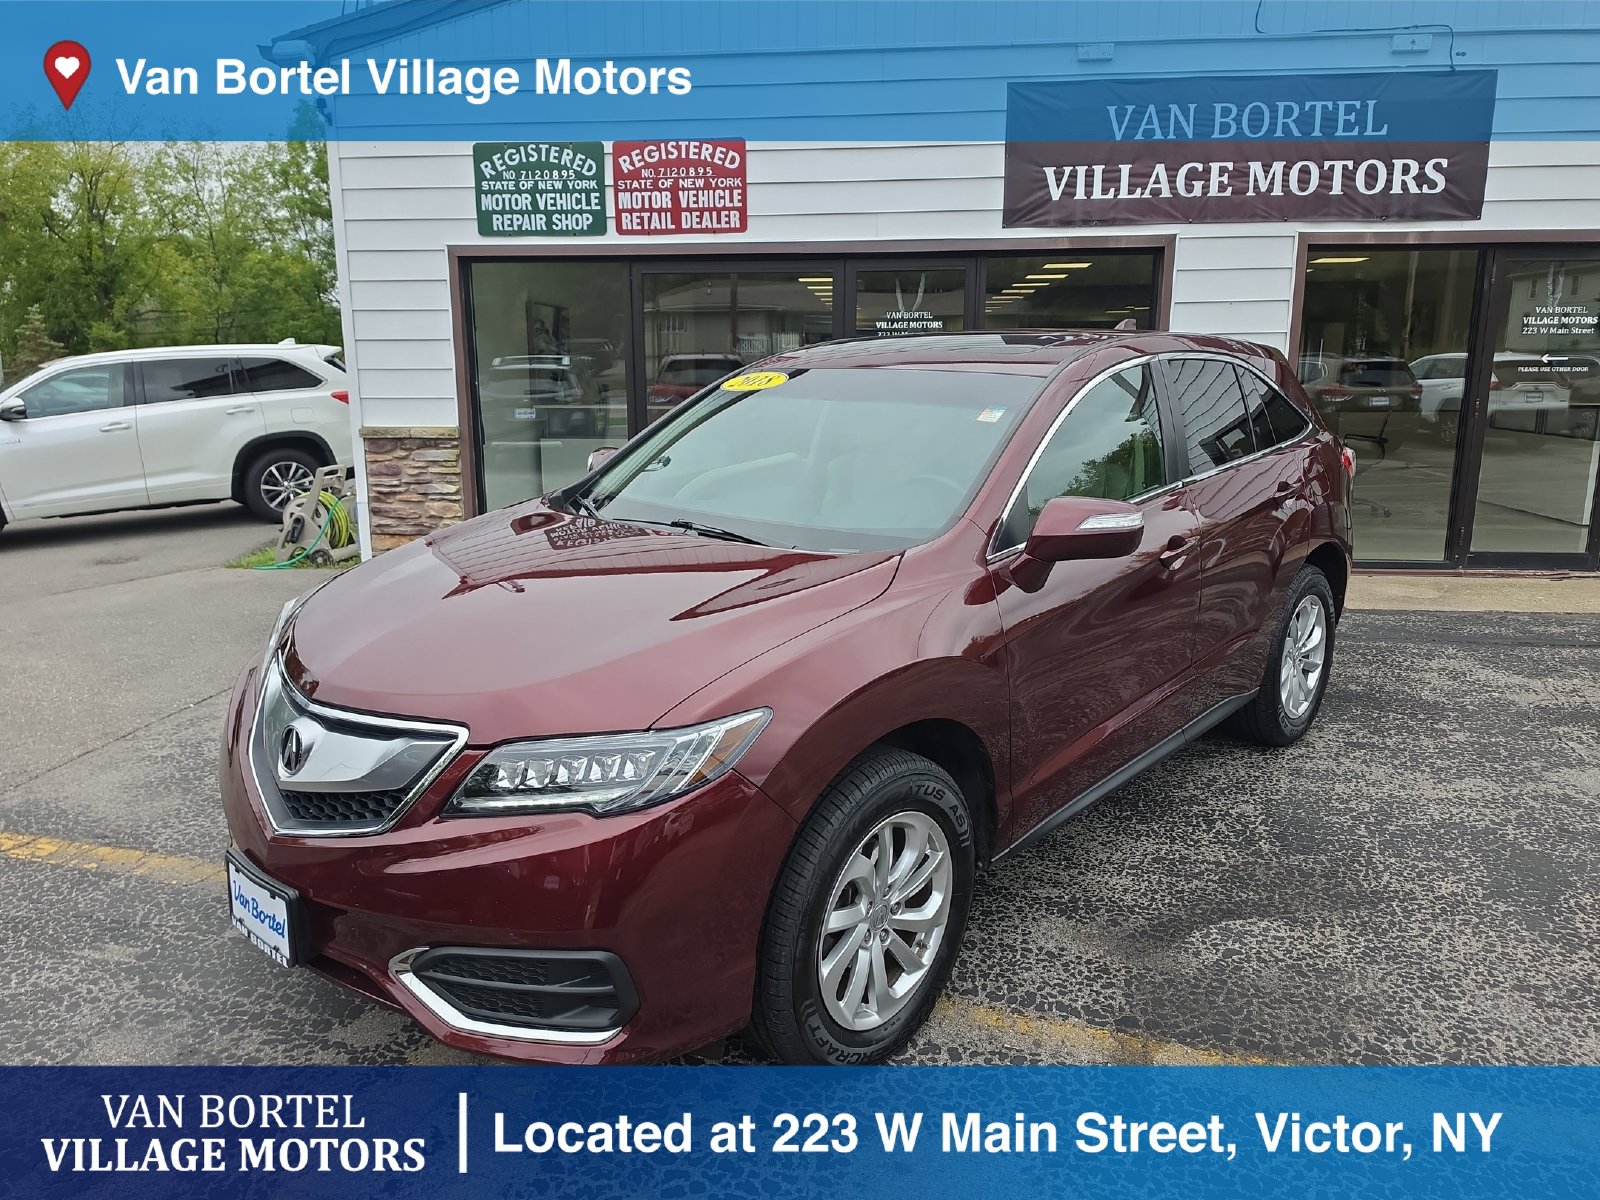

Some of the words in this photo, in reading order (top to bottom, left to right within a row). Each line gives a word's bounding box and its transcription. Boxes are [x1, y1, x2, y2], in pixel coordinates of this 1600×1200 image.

[1106, 104, 1198, 141] VAN
[1211, 99, 1388, 140] BORTEL
[480, 144, 597, 179] REGISTERED
[618, 141, 741, 174] REGISTERED
[520, 170, 576, 180] 7120895
[641, 168, 656, 178] NO.
[659, 167, 713, 177] 7120895
[1043, 161, 1234, 201] VILLAGE
[1247, 158, 1449, 197] MOTORS
[481, 181, 516, 190] STATE
[519, 181, 535, 190] OF
[538, 180, 564, 190] NEW
[567, 180, 598, 189] YORK
[617, 179, 653, 189] STATE
[658, 179, 674, 188] OF
[679, 178, 705, 188] NEW
[709, 177, 742, 187] YORK
[481, 193, 532, 211] MOTOR
[536, 192, 601, 210] VEHICLE
[618, 191, 672, 209] MOTOR
[679, 189, 742, 208] VEHICLE
[492, 213, 547, 231] REPAIR
[552, 213, 593, 231] SHOP
[621, 212, 676, 230] RETAIL
[681, 210, 740, 229] DEALER
[1535, 306, 1553, 314] VAN
[1554, 306, 1589, 314] BORTEL
[875, 321, 908, 329] VILLAGE
[909, 321, 944, 329] MOTORS
[1522, 316, 1559, 325] VILLAGE
[1560, 316, 1599, 324] MOTORS
[1570, 326, 1595, 334] Street
